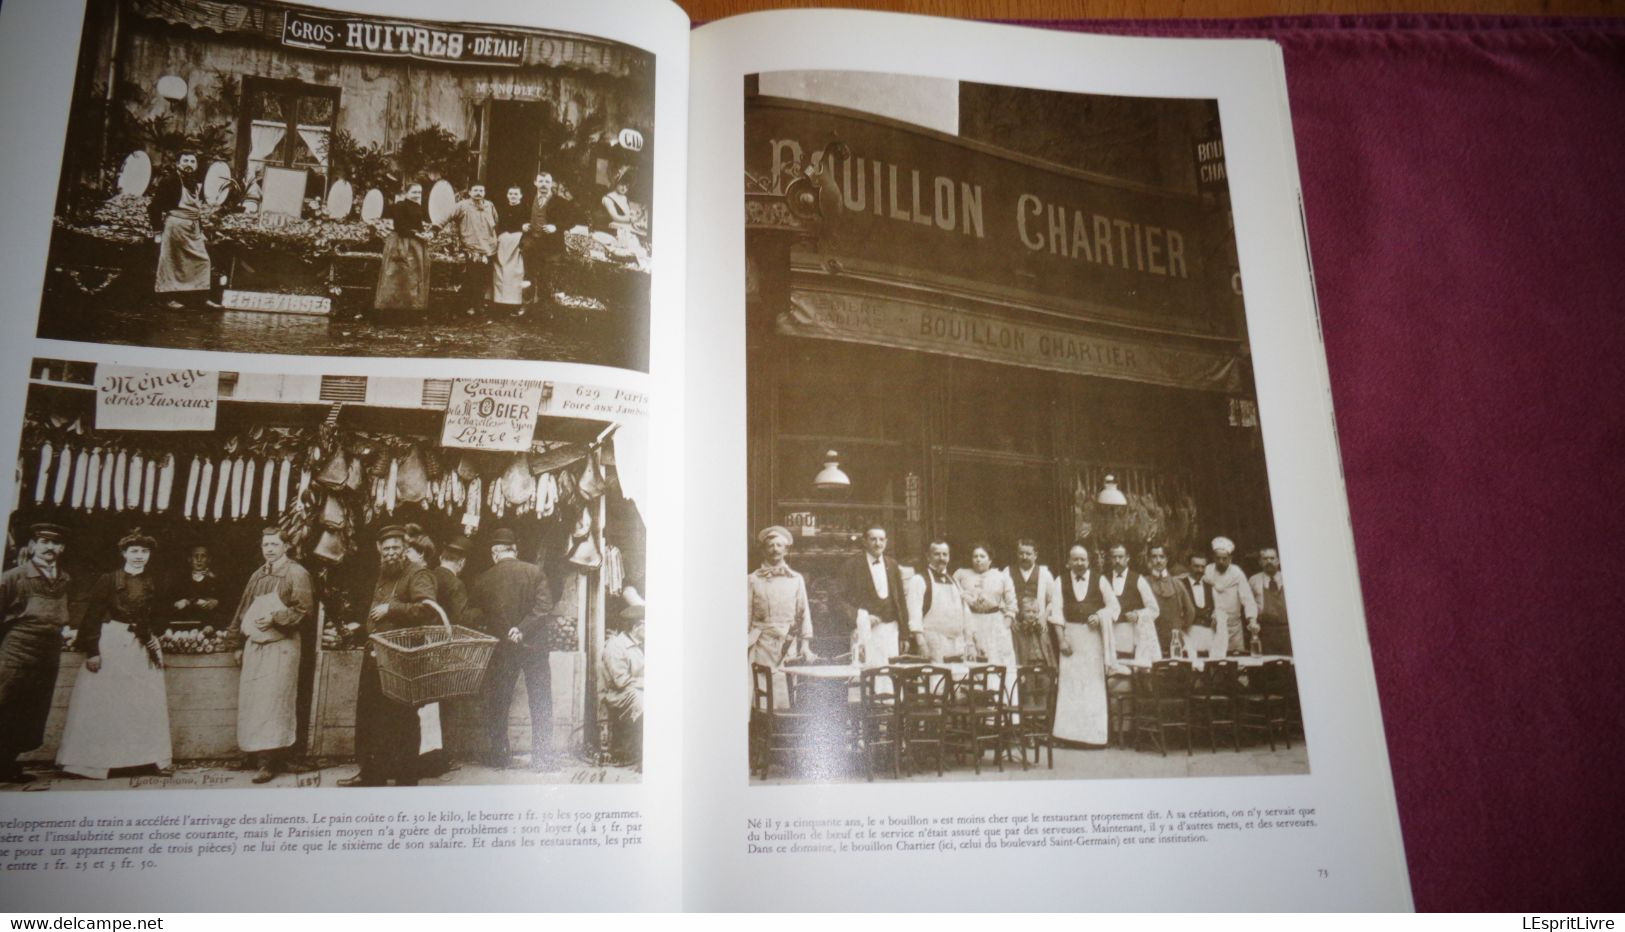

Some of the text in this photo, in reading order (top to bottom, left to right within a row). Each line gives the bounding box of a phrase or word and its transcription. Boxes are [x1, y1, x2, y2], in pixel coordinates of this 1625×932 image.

[291, 20, 334, 43] GROS
[345, 22, 465, 59] HUITRES
[473, 36, 520, 58] DÉTAIL
[1198, 139, 1223, 162] BOU
[1016, 193, 1188, 279] CHARTIER
[919, 314, 1026, 350] BOUILLON
[1039, 334, 1137, 368] CHARTIER
[576, 385, 649, 404] 629 Paris
[477, 396, 530, 420] OGIER
[562, 400, 591, 411] Foire
[593, 404, 614, 413] aux
[95, 816, 125, 827] train
[133, 815, 181, 826] accéléré
[181, 814, 237, 828] l'arrivage
[237, 813, 258, 824] des
[258, 813, 309, 824] aliments.
[328, 813, 353, 826] pain
[353, 812, 386, 823] coûte
[396, 811, 410, 822] fr.
[438, 810, 464, 824] kilo,
[478, 810, 515, 821] beurre
[524, 809, 538, 820] fr.
[556, 809, 572, 820] les
[593, 811, 643, 822] grammes.
[763, 829, 807, 841] bouillon
[880, 827, 915, 838] service
[917, 826, 948, 837] n'était
[950, 826, 981, 836] assuré
[983, 827, 1001, 839] que
[1004, 827, 1020, 838] par
[1022, 823, 1039, 834] des
[1041, 825, 1086, 834] serveuses.
[1090, 821, 1147, 835] Maintenant,
[1176, 819, 1214, 830] d'autres
[1216, 820, 1243, 831] mets,
[1256, 817, 1274, 828] des
[1274, 819, 1318, 828] serveurs.
[843, 818, 865, 829] ans,
[886, 814, 929, 825] bouillon
[939, 815, 954, 824] est
[955, 813, 986, 824] moins
[987, 812, 1009, 823] cher
[1010, 815, 1029, 826] que
[1041, 812, 1088, 822] restaurant
[1089, 811, 1144, 824] proprement
[1145, 808, 1162, 819] dit.
[1187, 807, 1230, 821] création,
[1246, 806, 1262, 820] n'y
[1264, 806, 1296, 817] servait
[1297, 808, 1316, 819] que
[44, 829, 115, 841] l'insalubrité
[118, 831, 144, 840] sont
[147, 828, 181, 839] chose
[184, 829, 239, 841] courante,
[242, 827, 269, 838] mais
[286, 825, 332, 837] Parisien
[335, 828, 374, 839] moyen
[377, 824, 395, 835] n'a
[398, 824, 430, 838] guère
[450, 823, 509, 837] problèmes
[520, 825, 541, 833] son
[544, 822, 572, 836] loyer
[610, 821, 623, 832] fr.
[625, 824, 643, 835] par
[13, 848, 45, 860] pour
[69, 845, 144, 858] appartement
[166, 843, 194, 854] trois
[196, 842, 238, 856] pièces)
[259, 841, 276, 852] lui
[278, 841, 299, 852] ôte
[301, 843, 324, 854] que
[340, 840, 384, 850] sixième
[404, 841, 425, 849] son
[428, 837, 467, 849] salaire.
[490, 836, 517, 848] dans
[520, 836, 536, 847] les
[539, 837, 601, 849] restaurants,
[604, 834, 619, 845] les
[621, 835, 643, 848] prix
[746, 842, 774, 854] Dans
[850, 840, 893, 851] bouillon
[895, 839, 936, 850] Chartier
[937, 838, 957, 851] (ici,
[958, 838, 982, 849] celui
[999, 836, 1047, 848] boulevard
[1048, 834, 1121, 849] Saint-Germain)
[1121, 836, 1136, 845] est
[1137, 836, 1156, 844] une
[1157, 833, 1209, 844] institution.
[5, 861, 38, 870] entre
[53, 858, 69, 869] fr.
[120, 857, 135, 868] fr.
